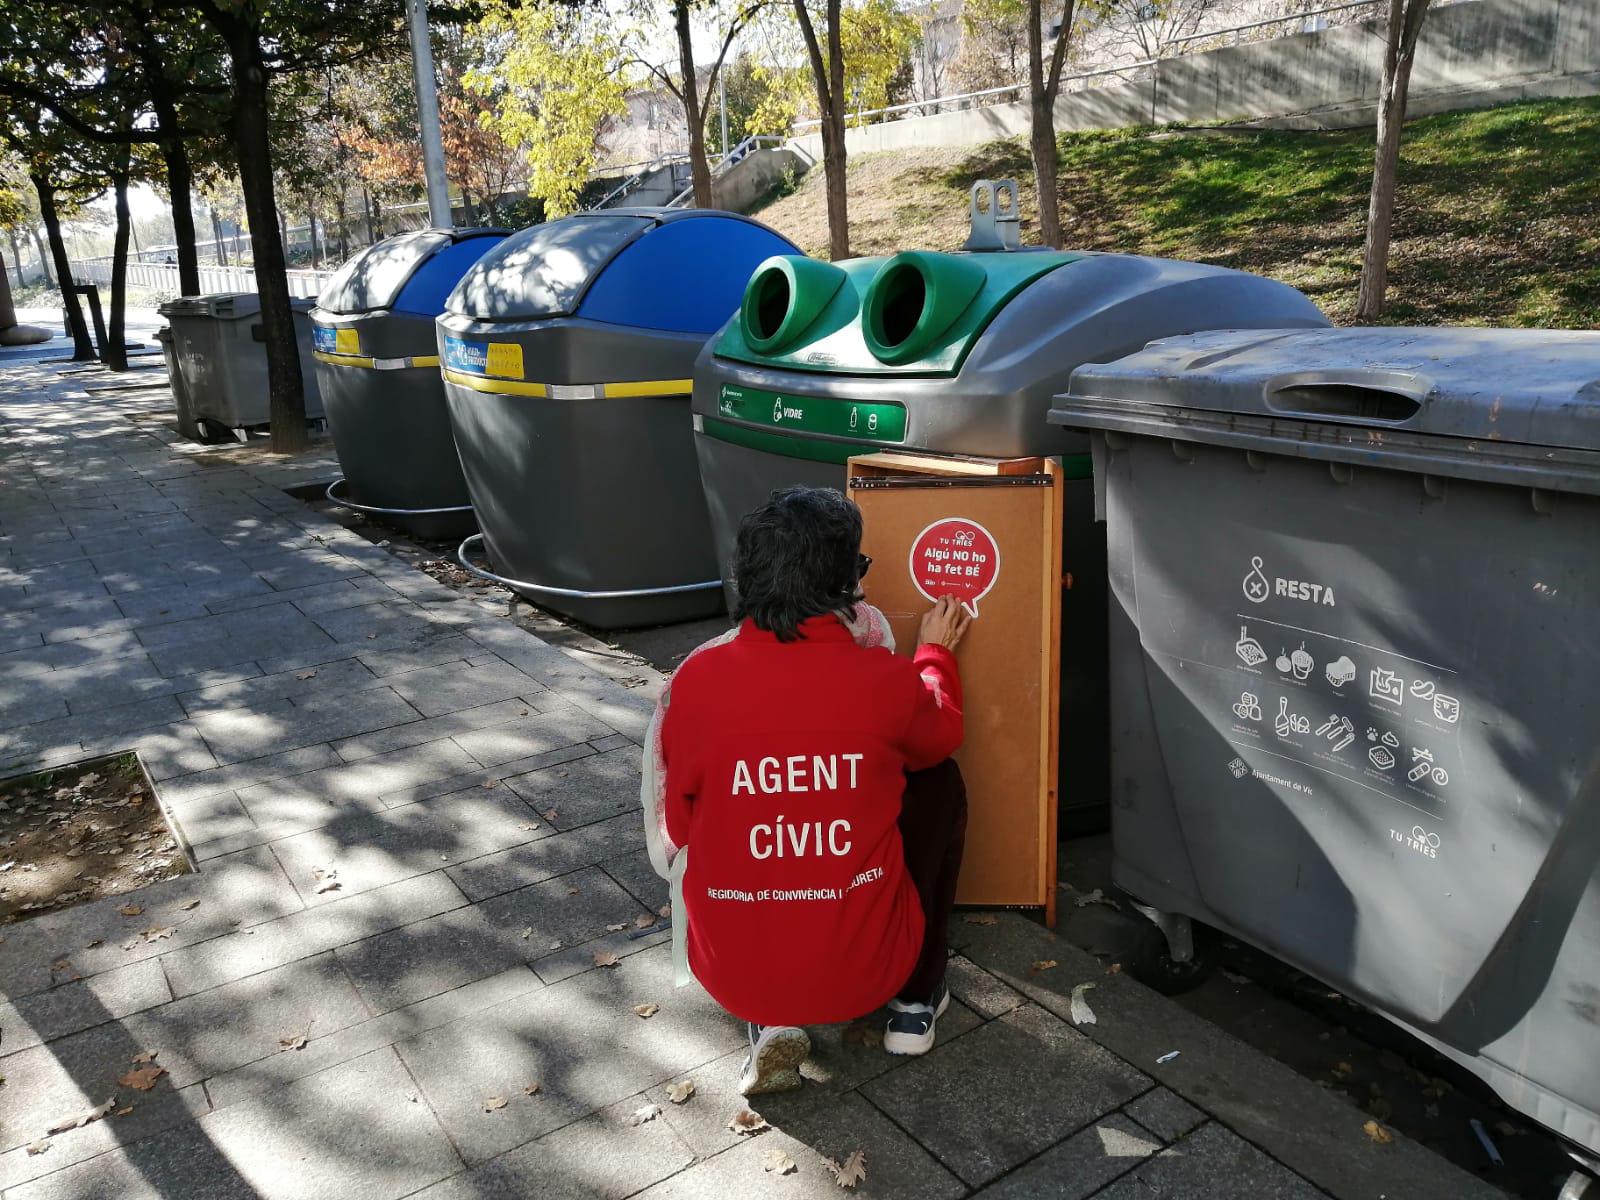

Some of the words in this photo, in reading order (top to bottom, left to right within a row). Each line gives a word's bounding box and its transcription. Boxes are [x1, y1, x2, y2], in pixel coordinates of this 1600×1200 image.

[783, 407, 803, 419] VIDRE
[924, 547, 949, 561] Algú
[953, 550, 969, 561] NO
[972, 551, 986, 563] ho
[927, 562, 941, 573] ha
[945, 563, 962, 575] fet
[965, 564, 980, 577] BÉ
[1274, 577, 1336, 607] RESTA
[731, 753, 864, 796] AGENT
[1252, 769, 1291, 788] Ajuntament
[1293, 783, 1301, 792] de
[748, 815, 852, 860] CÍVIC
[1389, 828, 1403, 844] TU
[1406, 836, 1437, 859] TRIES
[707, 887, 755, 902] REGIDORIA
[757, 889, 770, 901] DE
